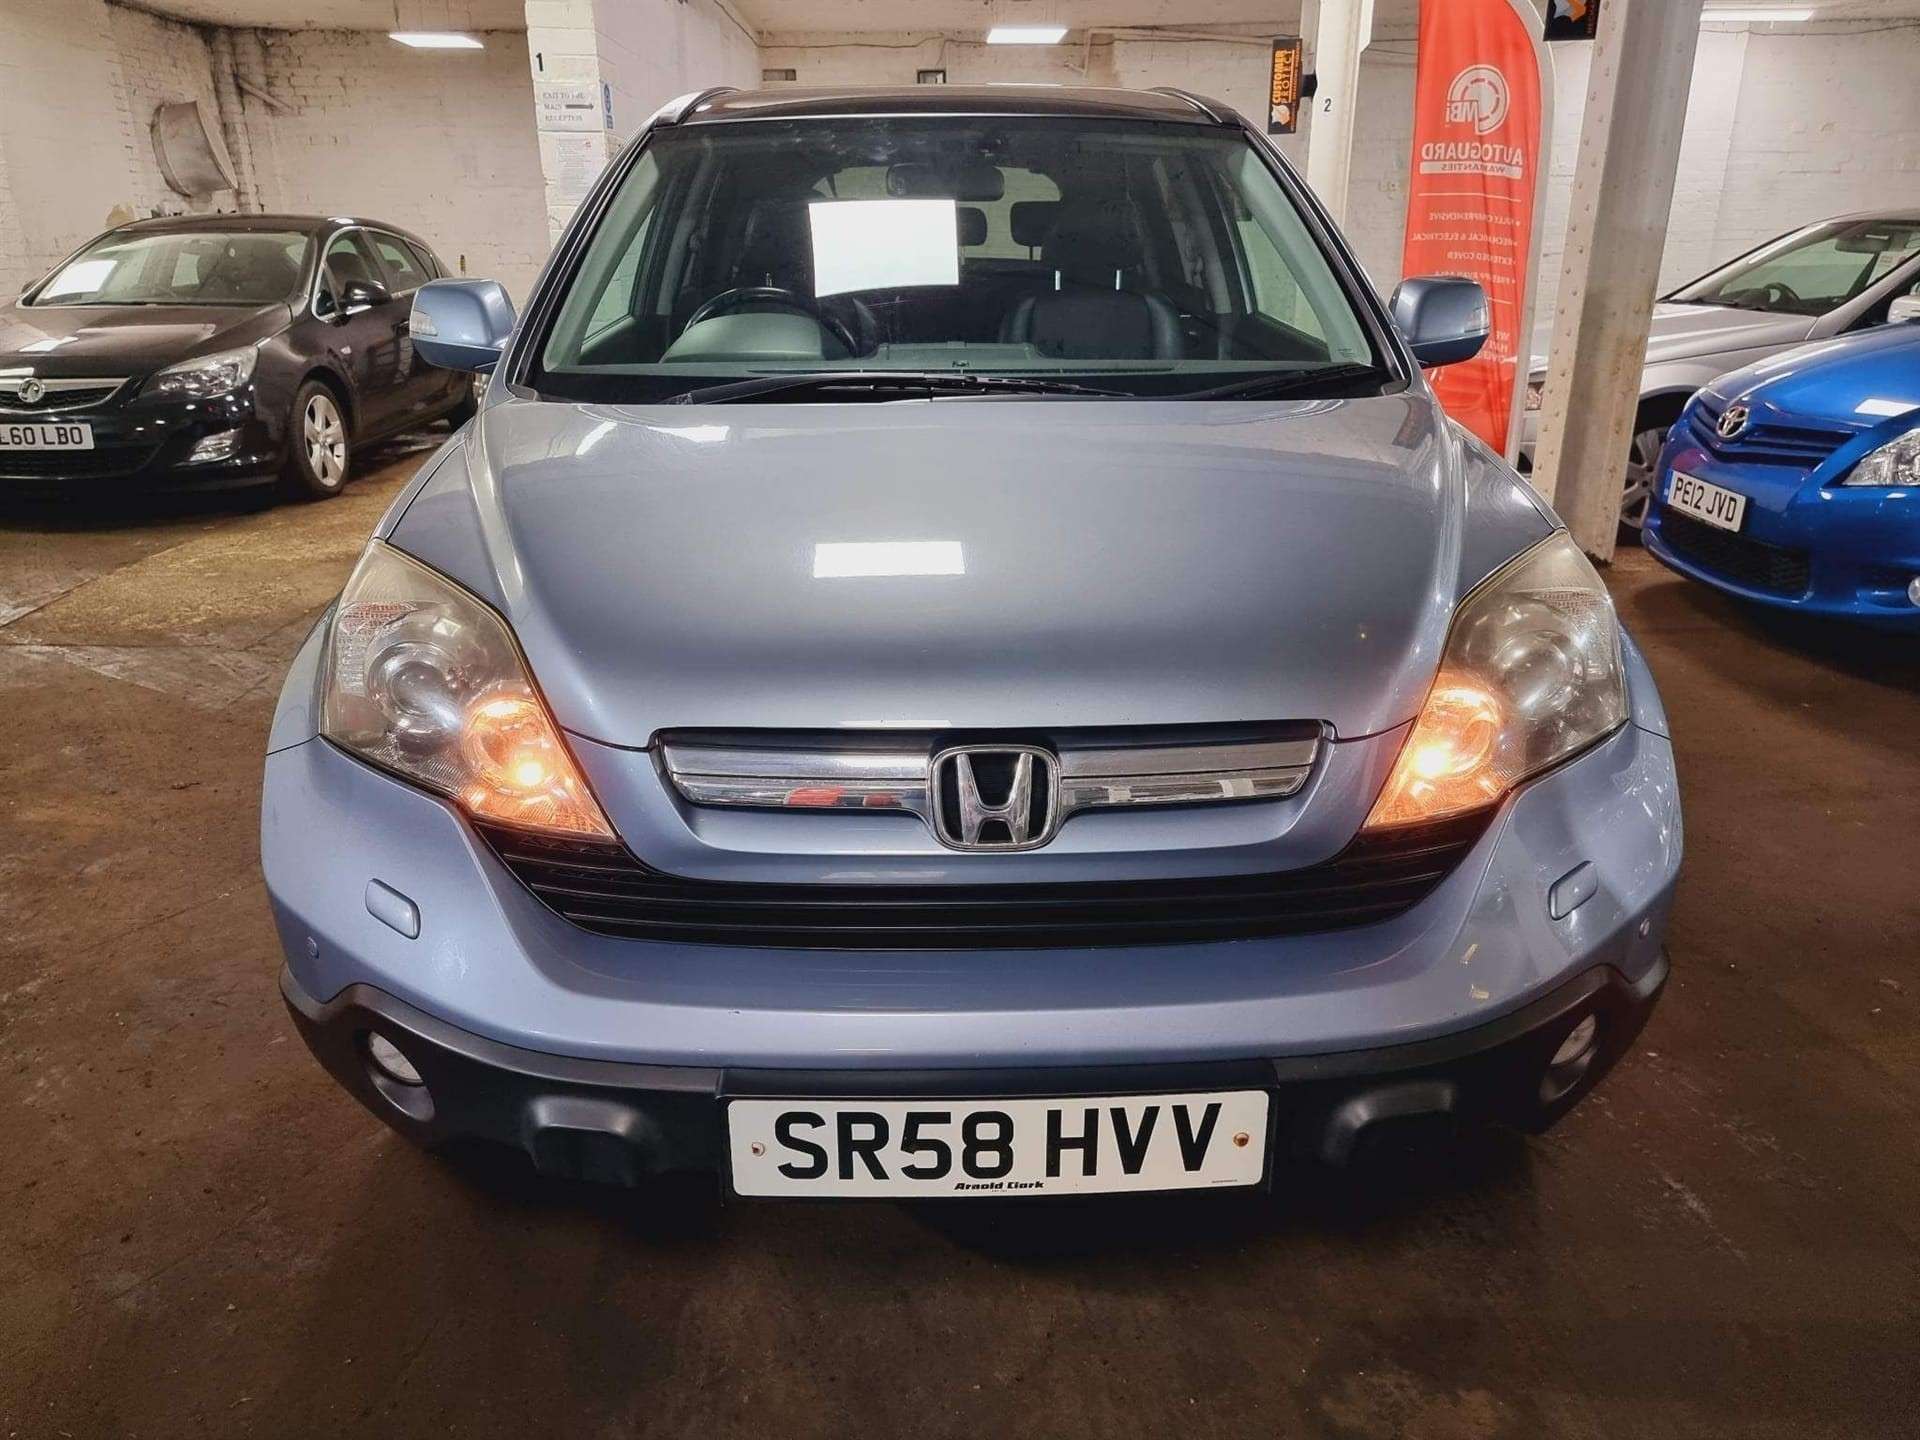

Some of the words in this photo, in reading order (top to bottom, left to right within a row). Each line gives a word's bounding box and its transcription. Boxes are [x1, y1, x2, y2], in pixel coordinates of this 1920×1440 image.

[535, 53, 544, 72] 1
[1273, 50, 1286, 103] CUSTOMER
[1324, 98, 1332, 112] 2
[1706, 491, 1737, 522] JVD
[774, 1110, 1014, 1181] SR58
[1046, 1102, 1222, 1178] HVV
[954, 1182, 1004, 1190] Arnold
[1007, 1180, 1045, 1189] Clark
